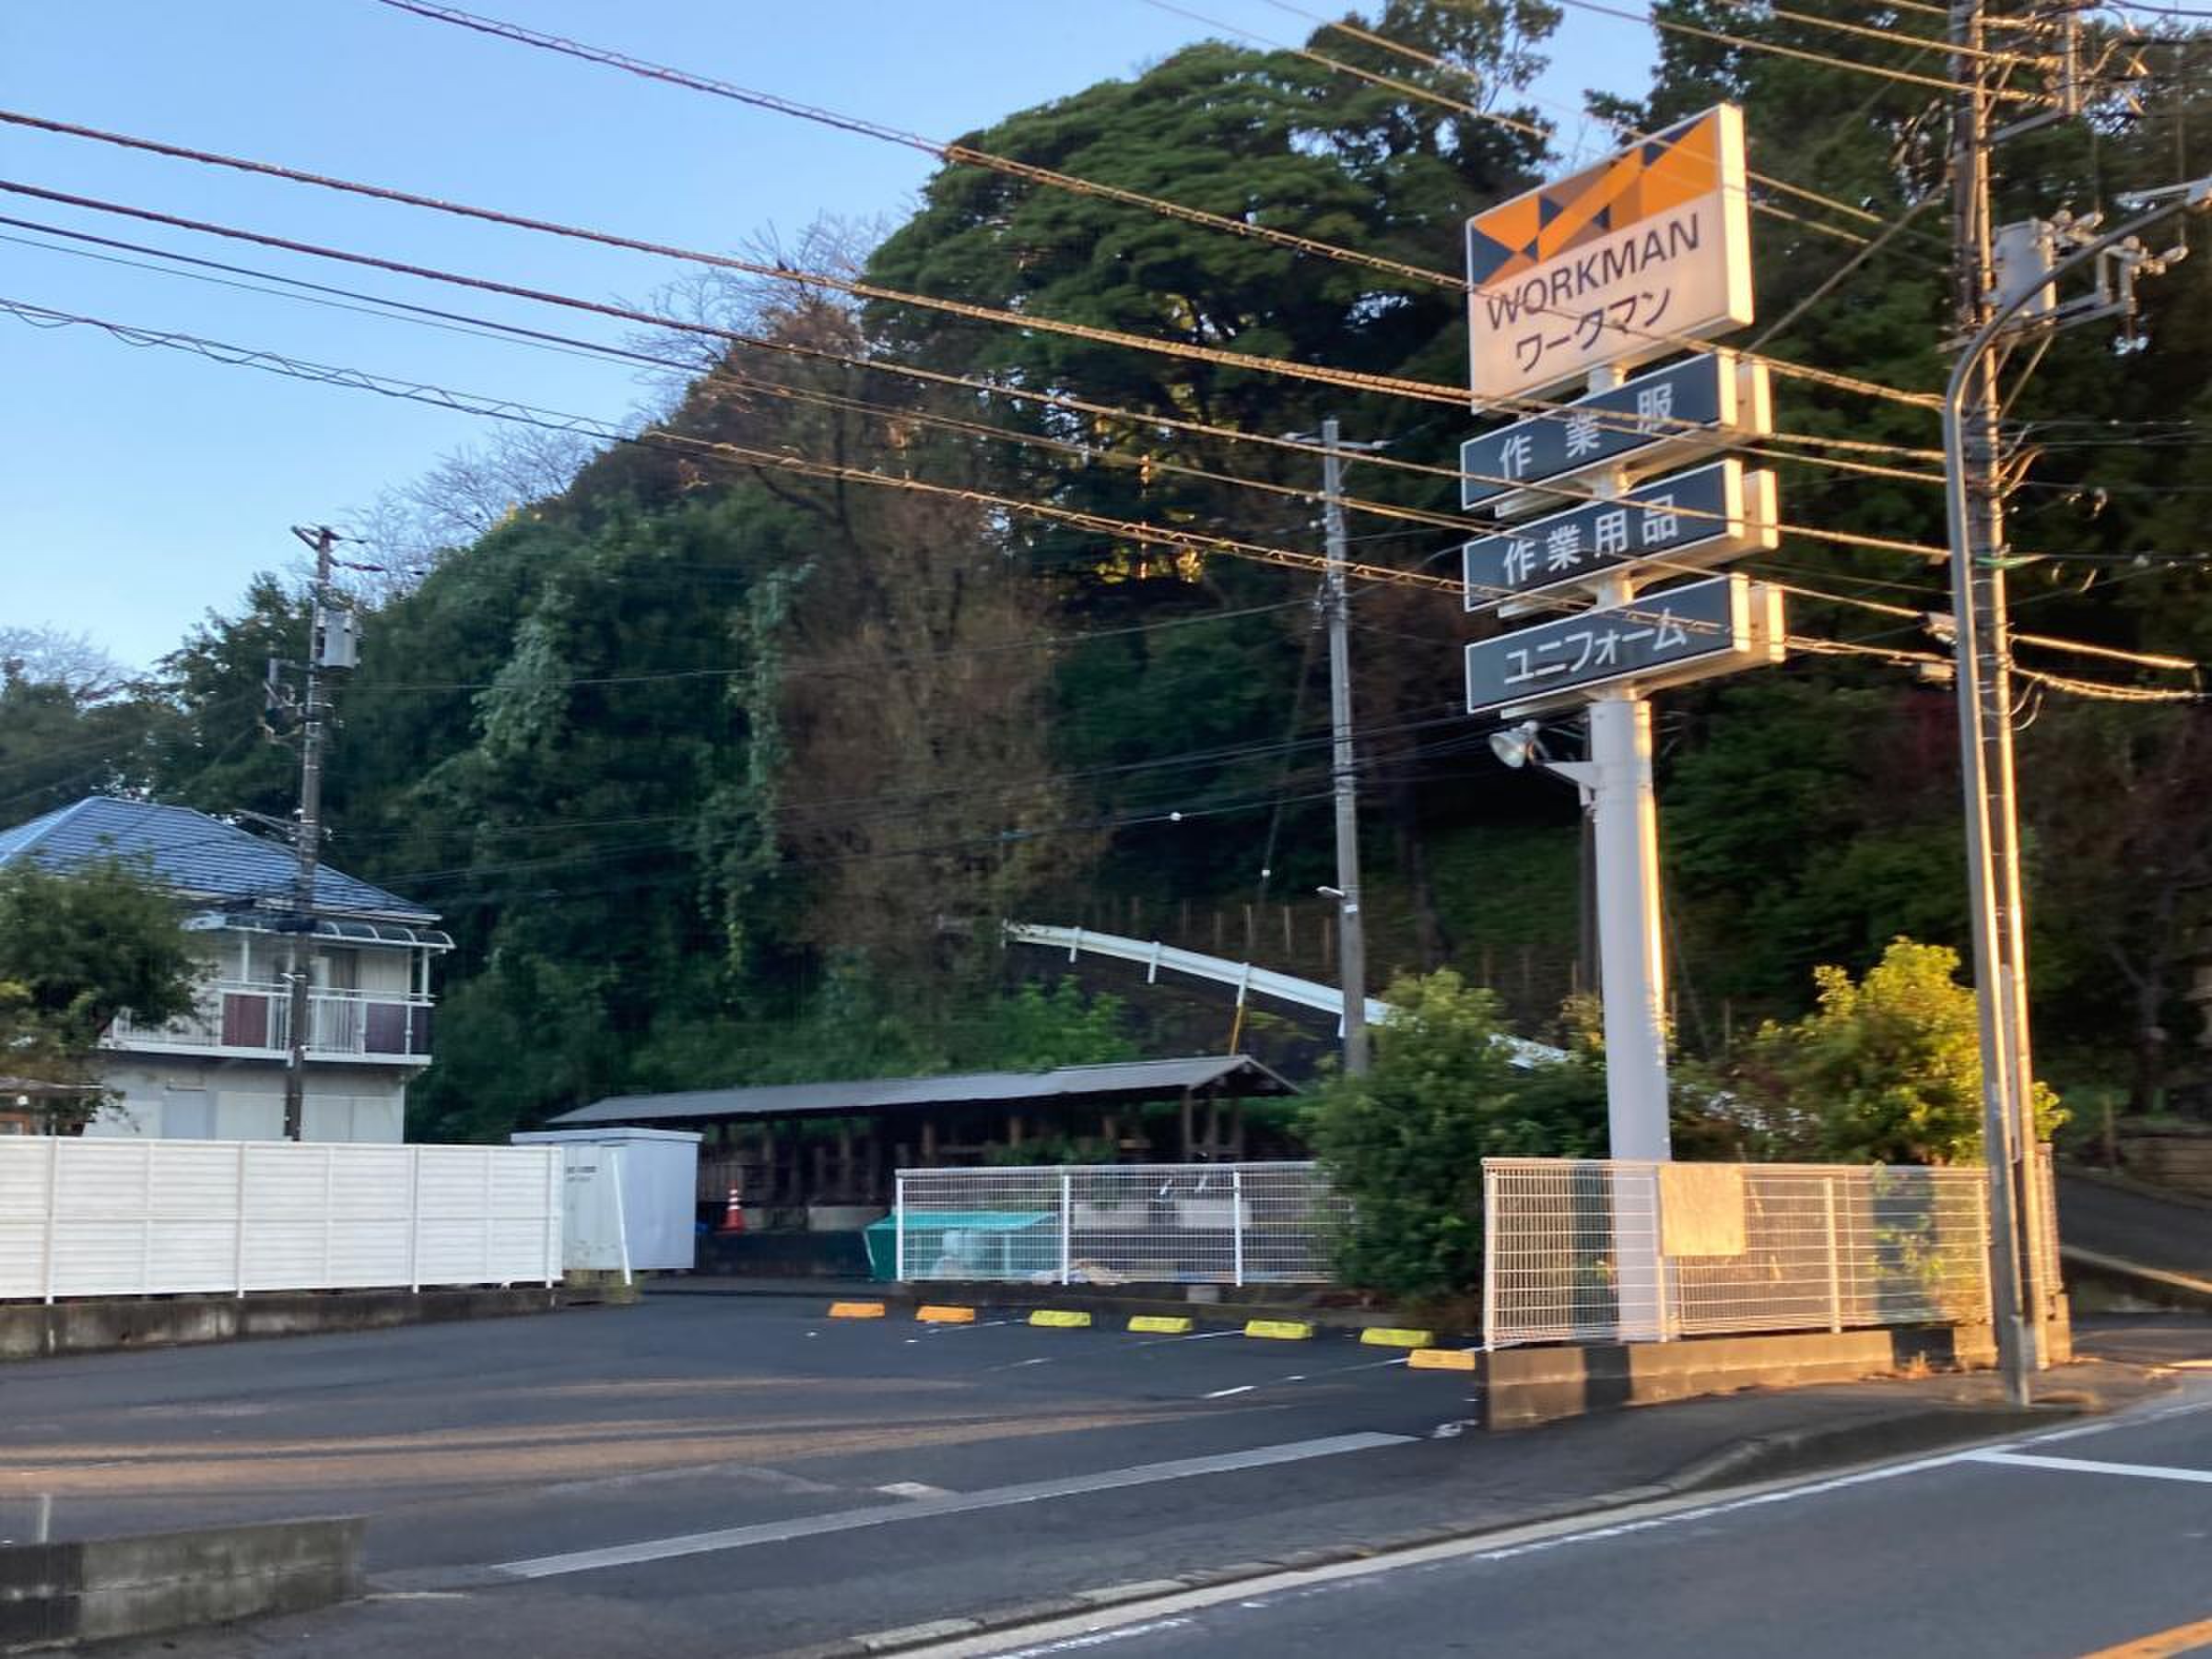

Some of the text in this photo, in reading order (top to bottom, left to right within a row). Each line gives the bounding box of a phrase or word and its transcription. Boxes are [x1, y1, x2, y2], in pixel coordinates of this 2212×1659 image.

[1487, 213, 1700, 331] WORKMAN
[1516, 288, 1670, 372] ワークマン
[1499, 382, 1673, 480] 作業服
[1503, 494, 1678, 585] 作業用品
[1503, 607, 1687, 685] ユニフォーム
